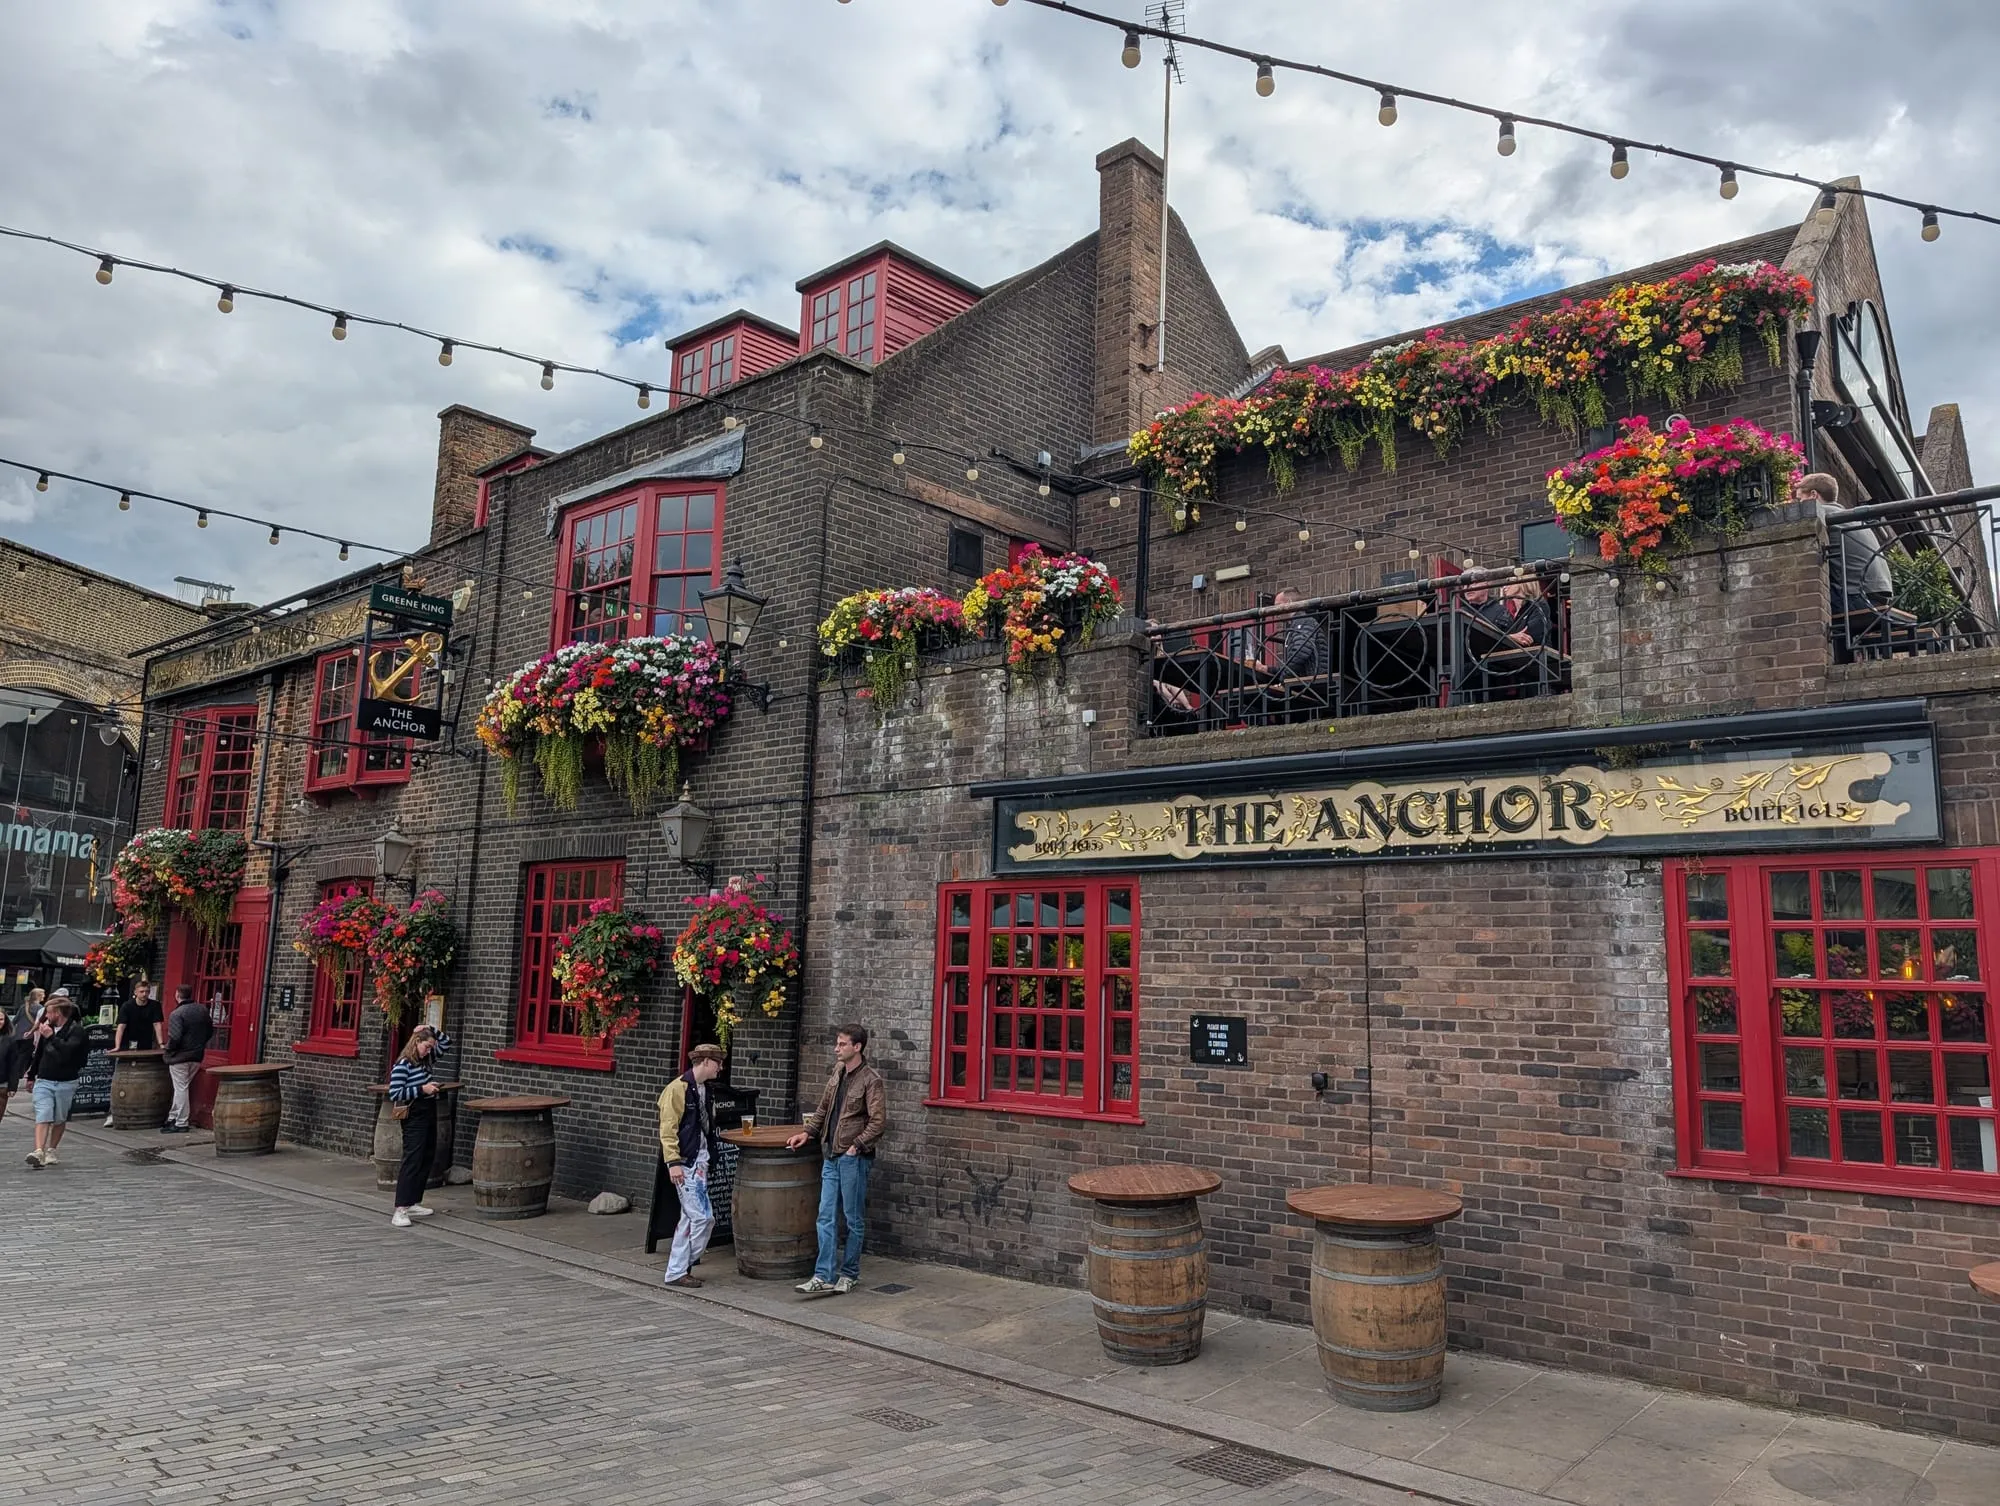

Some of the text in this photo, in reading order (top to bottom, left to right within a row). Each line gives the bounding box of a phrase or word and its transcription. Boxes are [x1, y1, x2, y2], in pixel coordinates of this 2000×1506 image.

[381, 593, 419, 609] GREENE
[421, 602, 445, 615] KING
[373, 707, 426, 734] THE ANCHOR
[1175, 777, 1597, 847] THE ANCHOR
[1799, 802, 1848, 819] 1615
[0, 822, 96, 859] mama
